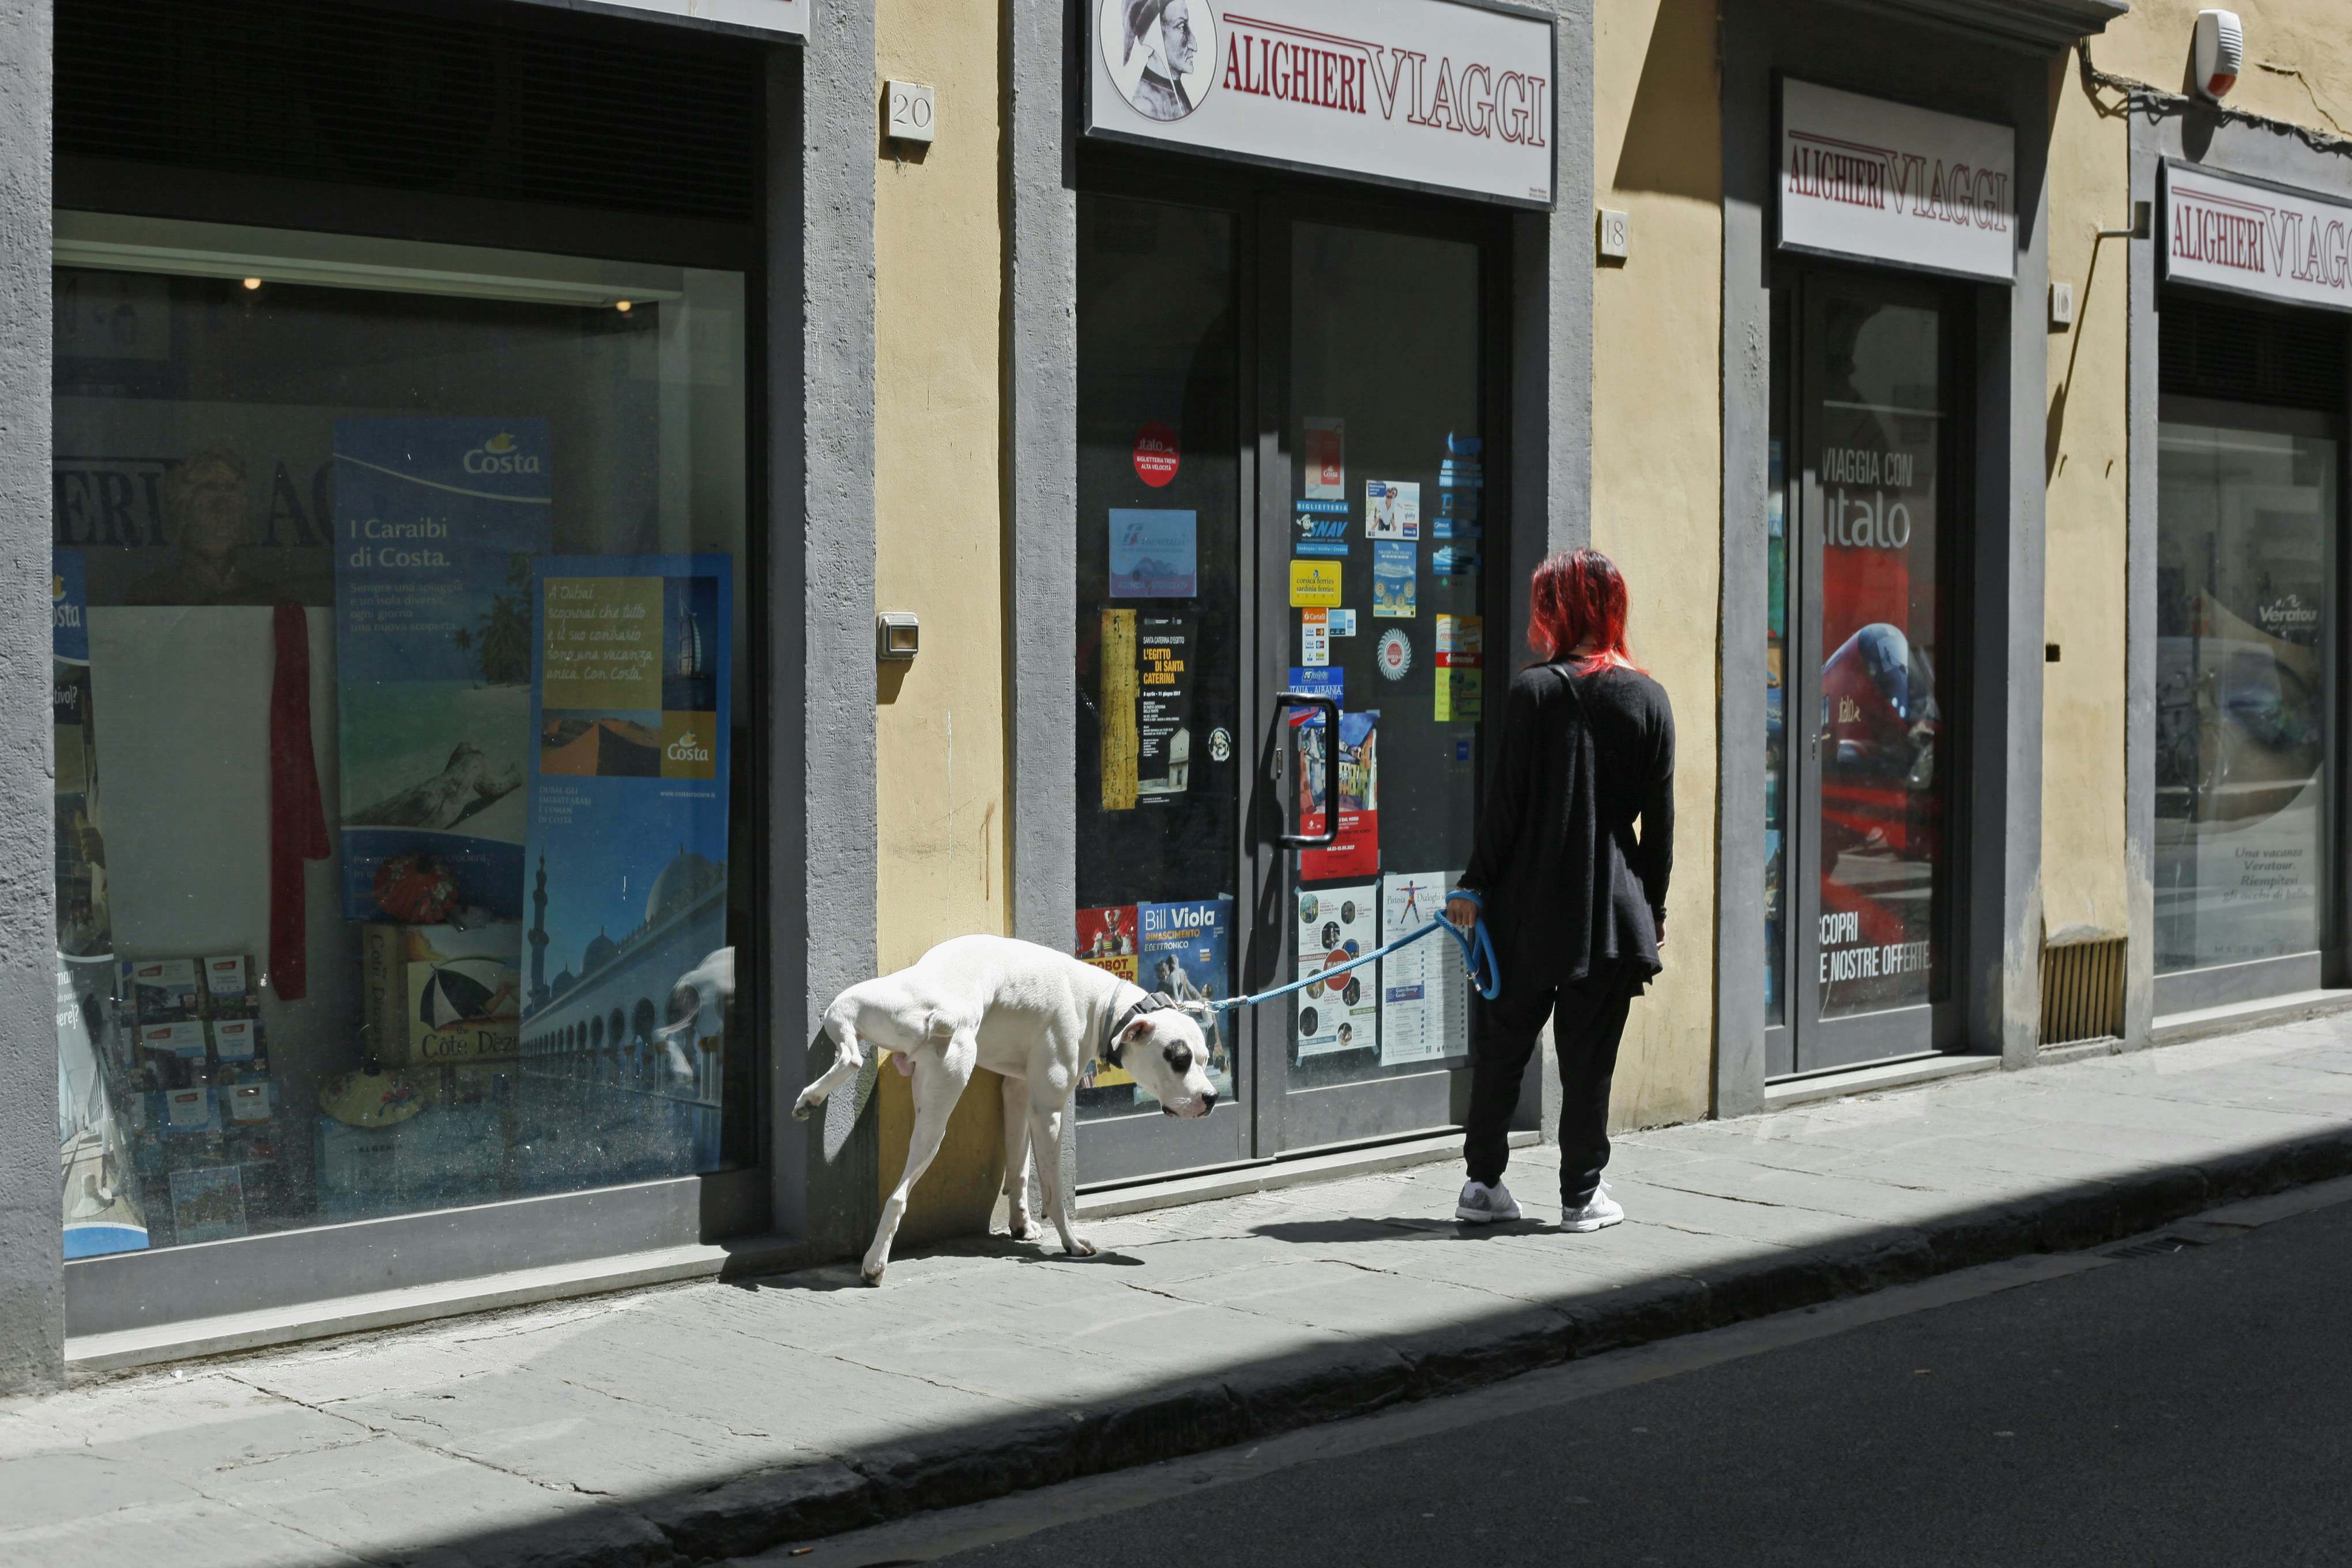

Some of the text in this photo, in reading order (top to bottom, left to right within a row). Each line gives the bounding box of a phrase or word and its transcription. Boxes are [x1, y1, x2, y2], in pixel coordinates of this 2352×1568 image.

[1223, 31, 1546, 148] ALIGHIERI VIAGGI
[894, 94, 931, 127] 20
[1789, 145, 2007, 232] ALIGHIERI VIAGGI
[1607, 220, 1624, 246] 18
[2172, 203, 2352, 289] ALIGHIERI VIAG
[463, 449, 540, 474] Costa
[1136, 455, 1163, 463] BIGLIETTERIA
[1323, 470, 1338, 478] Costa
[1822, 447, 1913, 487] VIAGGIA CON
[1297, 503, 1347, 511] BIGLIETTERIA
[1404, 512, 1416, 520] globy
[350, 517, 447, 539] I Caraibi
[1310, 521, 1348, 537] SNAV
[350, 546, 451, 568] di Costa.
[350, 582, 391, 595] Sempre
[395, 584, 415, 592] una
[549, 583, 595, 600] A Dubai
[350, 610, 413, 621] ogni giorno
[599, 605, 620, 619] che
[623, 603, 646, 619] tutto
[570, 631, 586, 640] suo
[590, 625, 641, 641] contrario
[548, 650, 574, 660] sono
[604, 650, 654, 668] vacanza
[1143, 648, 1171, 660] L'EGITTO
[1446, 653, 1475, 664] tirrenia
[584, 666, 608, 680] Con
[1155, 660, 1184, 672] DI SANTA
[1143, 673, 1175, 684] CATERINA
[1290, 685, 1309, 693] ITALIA
[667, 745, 709, 762] Costa
[570, 797, 591, 805] ARABI
[549, 816, 572, 824] COSTA
[2235, 847, 2303, 858] Una vacanza
[2244, 860, 2296, 871] Veratour.
[2241, 873, 2299, 889] Riempitevi
[1387, 892, 1440, 904] Pistoia Dialoghi
[2222, 888, 2238, 903] gli
[2241, 888, 2270, 900] occhi
[1145, 905, 1215, 931] Bill Viola
[1145, 929, 1200, 941] RINASCIMENTO
[1819, 911, 1858, 945] COPRI
[1144, 941, 1189, 952] ELETTRONICO
[1088, 959, 1128, 971] OBOT
[1830, 945, 1879, 982] NOSTRE
[422, 1034, 468, 1059] Côte
